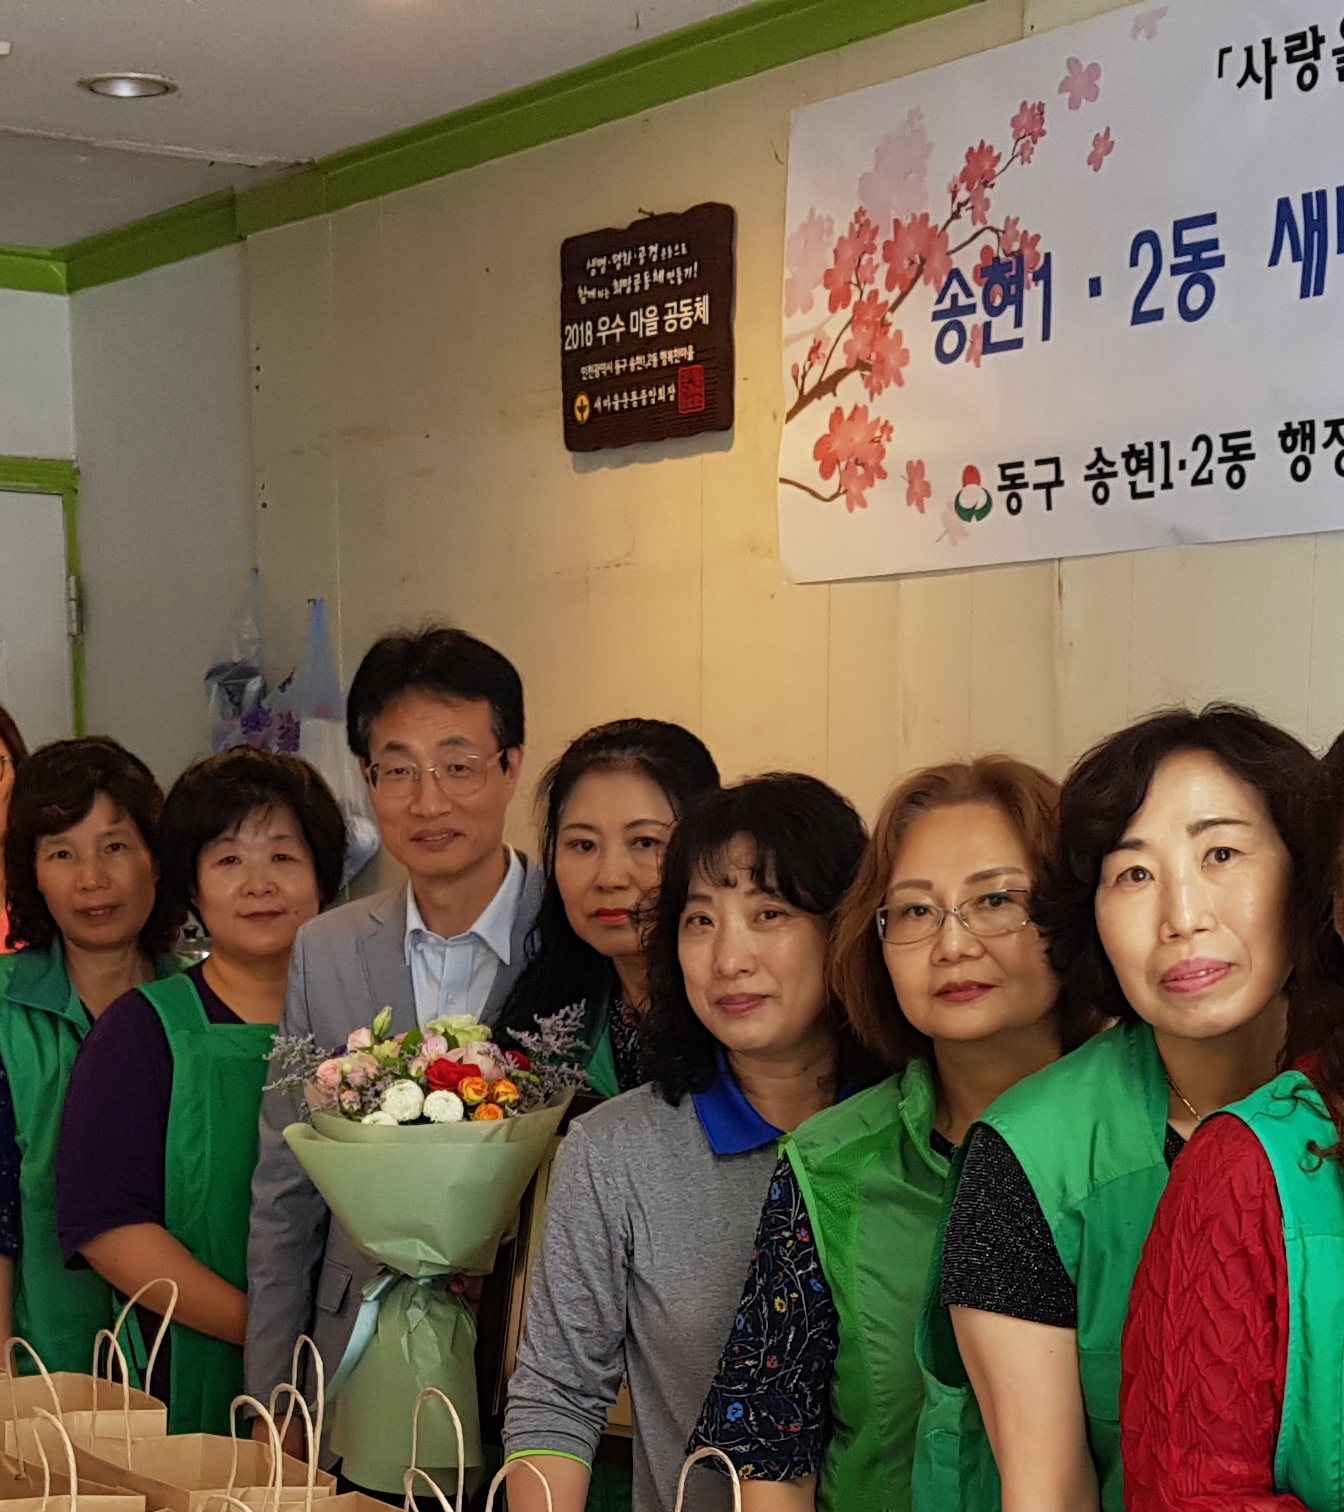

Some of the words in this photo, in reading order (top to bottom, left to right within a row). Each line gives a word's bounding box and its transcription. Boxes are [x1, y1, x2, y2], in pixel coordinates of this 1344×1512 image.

[564, 320, 593, 350] 2018
[596, 313, 625, 345] 우수
[630, 305, 659, 338] 마을
[663, 293, 709, 333] 공동체
[997, 456, 1065, 515] 동구
[1084, 430, 1256, 505] 송현1·2동
